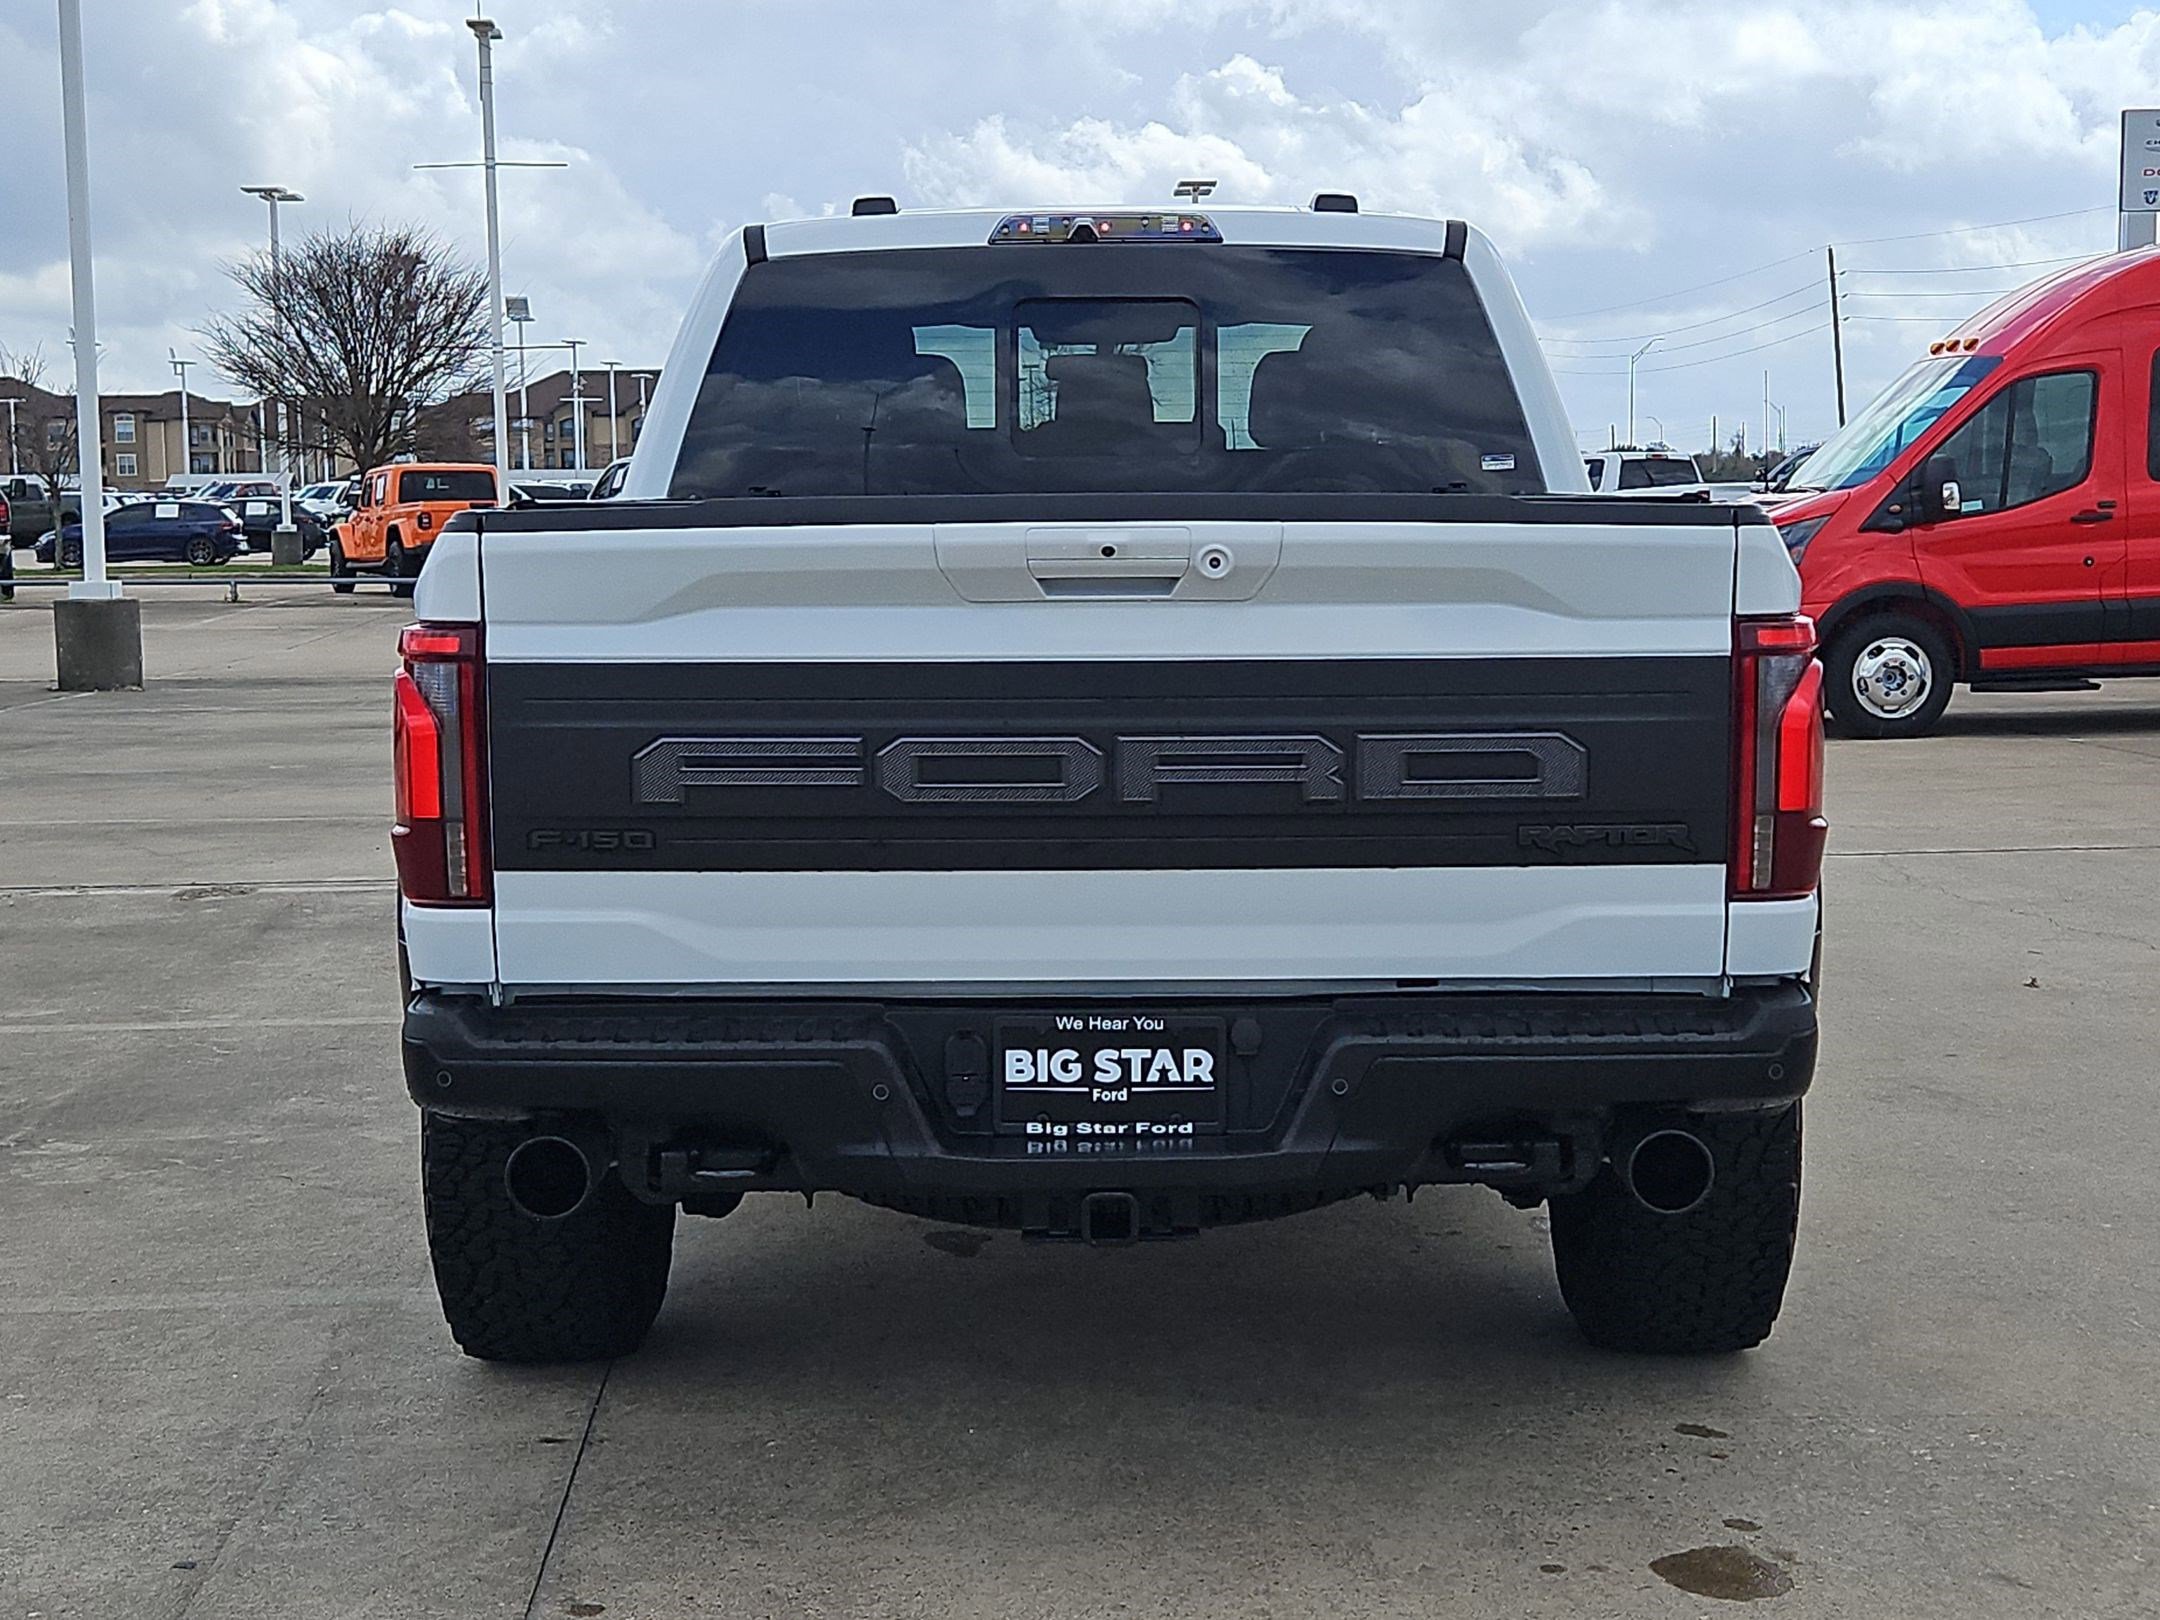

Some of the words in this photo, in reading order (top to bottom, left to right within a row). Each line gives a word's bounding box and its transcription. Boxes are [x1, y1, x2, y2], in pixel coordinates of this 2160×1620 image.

[630, 732, 1589, 804] FORD
[528, 829, 654, 850] F-150
[1517, 823, 1697, 855] RAPTOR
[1056, 1016, 1083, 1030] We
[1089, 1016, 1129, 1030] Hear
[1132, 1016, 1164, 1030] You
[1005, 1049, 1082, 1083] BIG
[1094, 1049, 1214, 1083] STAR
[1092, 1087, 1128, 1101] Ford
[1026, 1122, 1068, 1136] Big
[1076, 1122, 1128, 1134] Star
[1135, 1122, 1193, 1134] Ford
